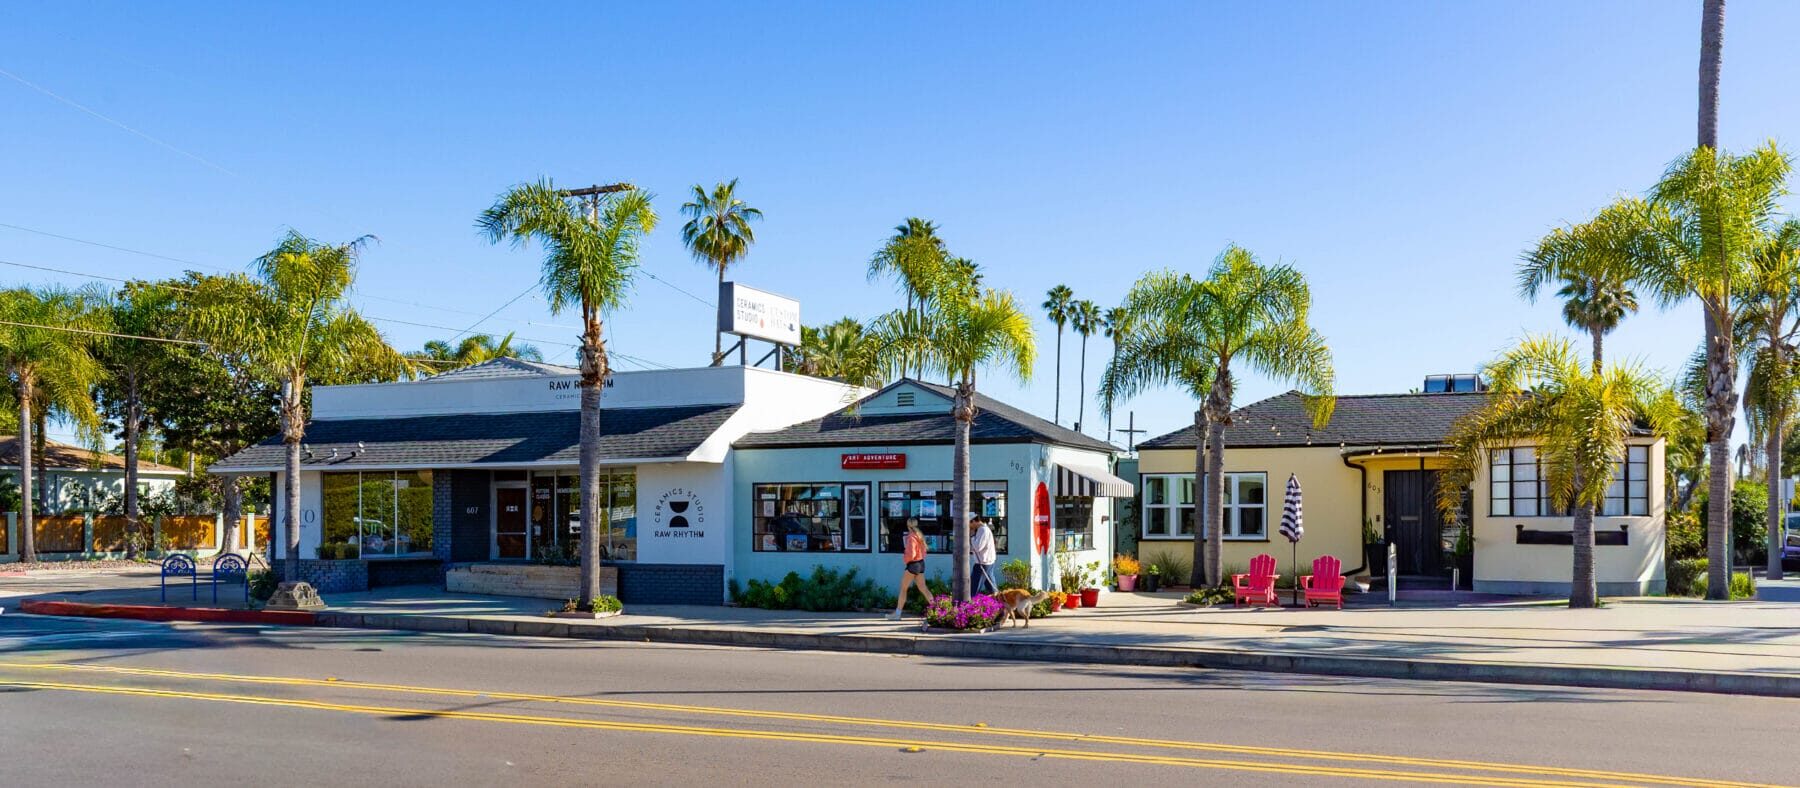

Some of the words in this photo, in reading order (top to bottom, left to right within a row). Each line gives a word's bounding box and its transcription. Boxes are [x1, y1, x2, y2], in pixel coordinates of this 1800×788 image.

[736, 297, 766, 314] CERAMICS
[549, 380, 571, 391] RAW
[466, 506, 479, 515] 607
[654, 488, 683, 523] CERAMICS
[686, 490, 705, 523] STUDIO
[654, 530, 671, 538] RAW
[673, 530, 705, 538] RHYTHM
